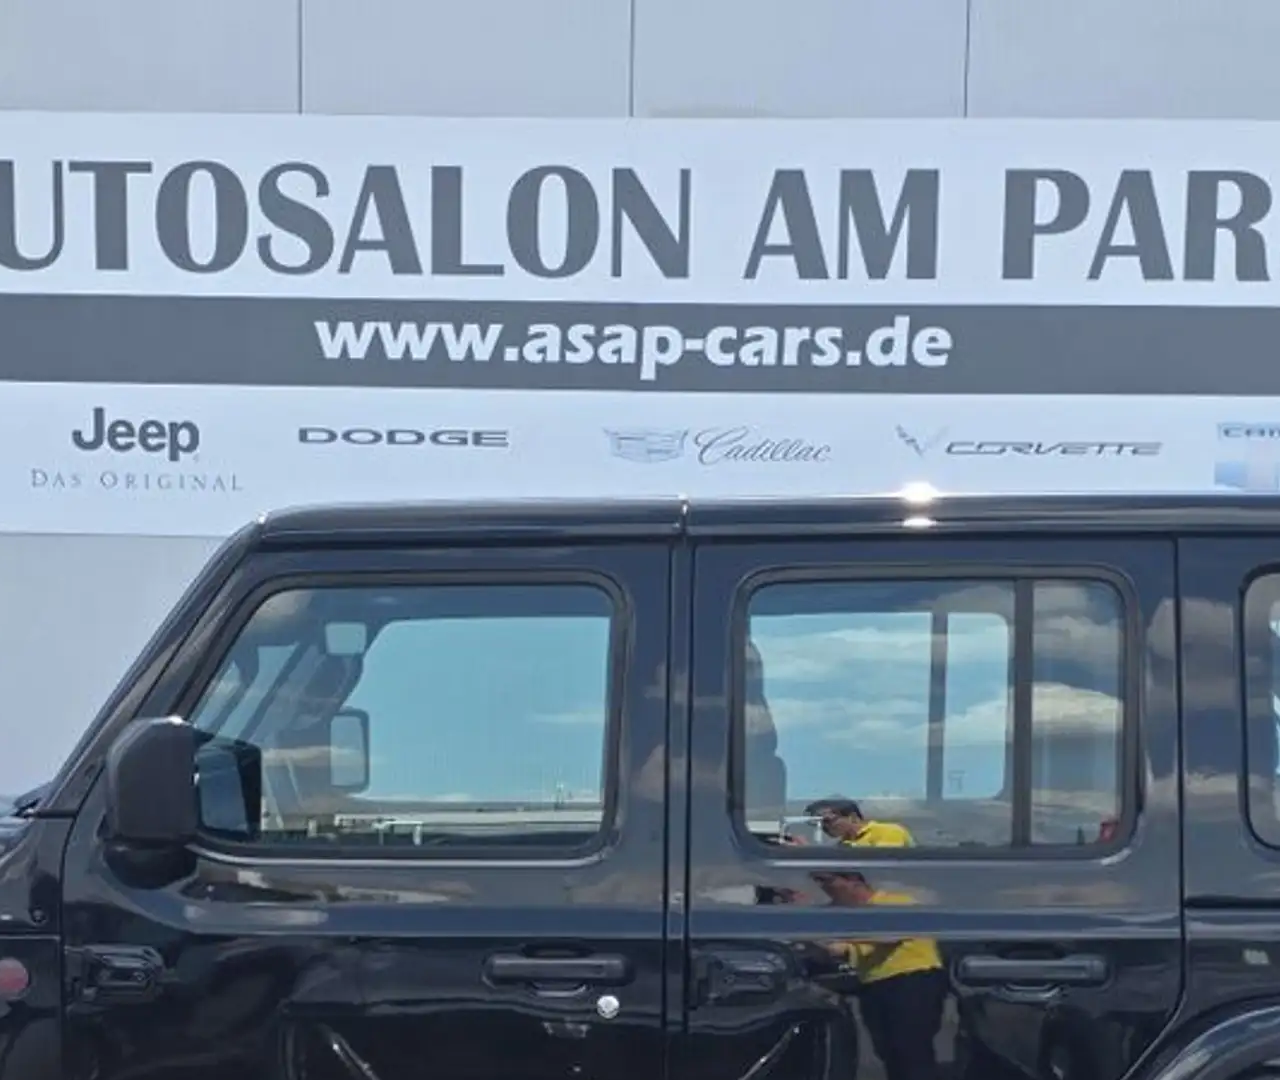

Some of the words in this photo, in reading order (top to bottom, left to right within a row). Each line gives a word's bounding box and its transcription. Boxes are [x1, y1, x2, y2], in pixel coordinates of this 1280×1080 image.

[743, 168, 940, 281] AM
[314, 315, 954, 381] www.asap-cars.de
[71, 406, 200, 462] Jeep
[297, 426, 510, 448] DODGE
[693, 424, 833, 466] Cadillac
[944, 440, 1164, 456] CORVETTE
[99, 470, 245, 492] ORIGINAL
